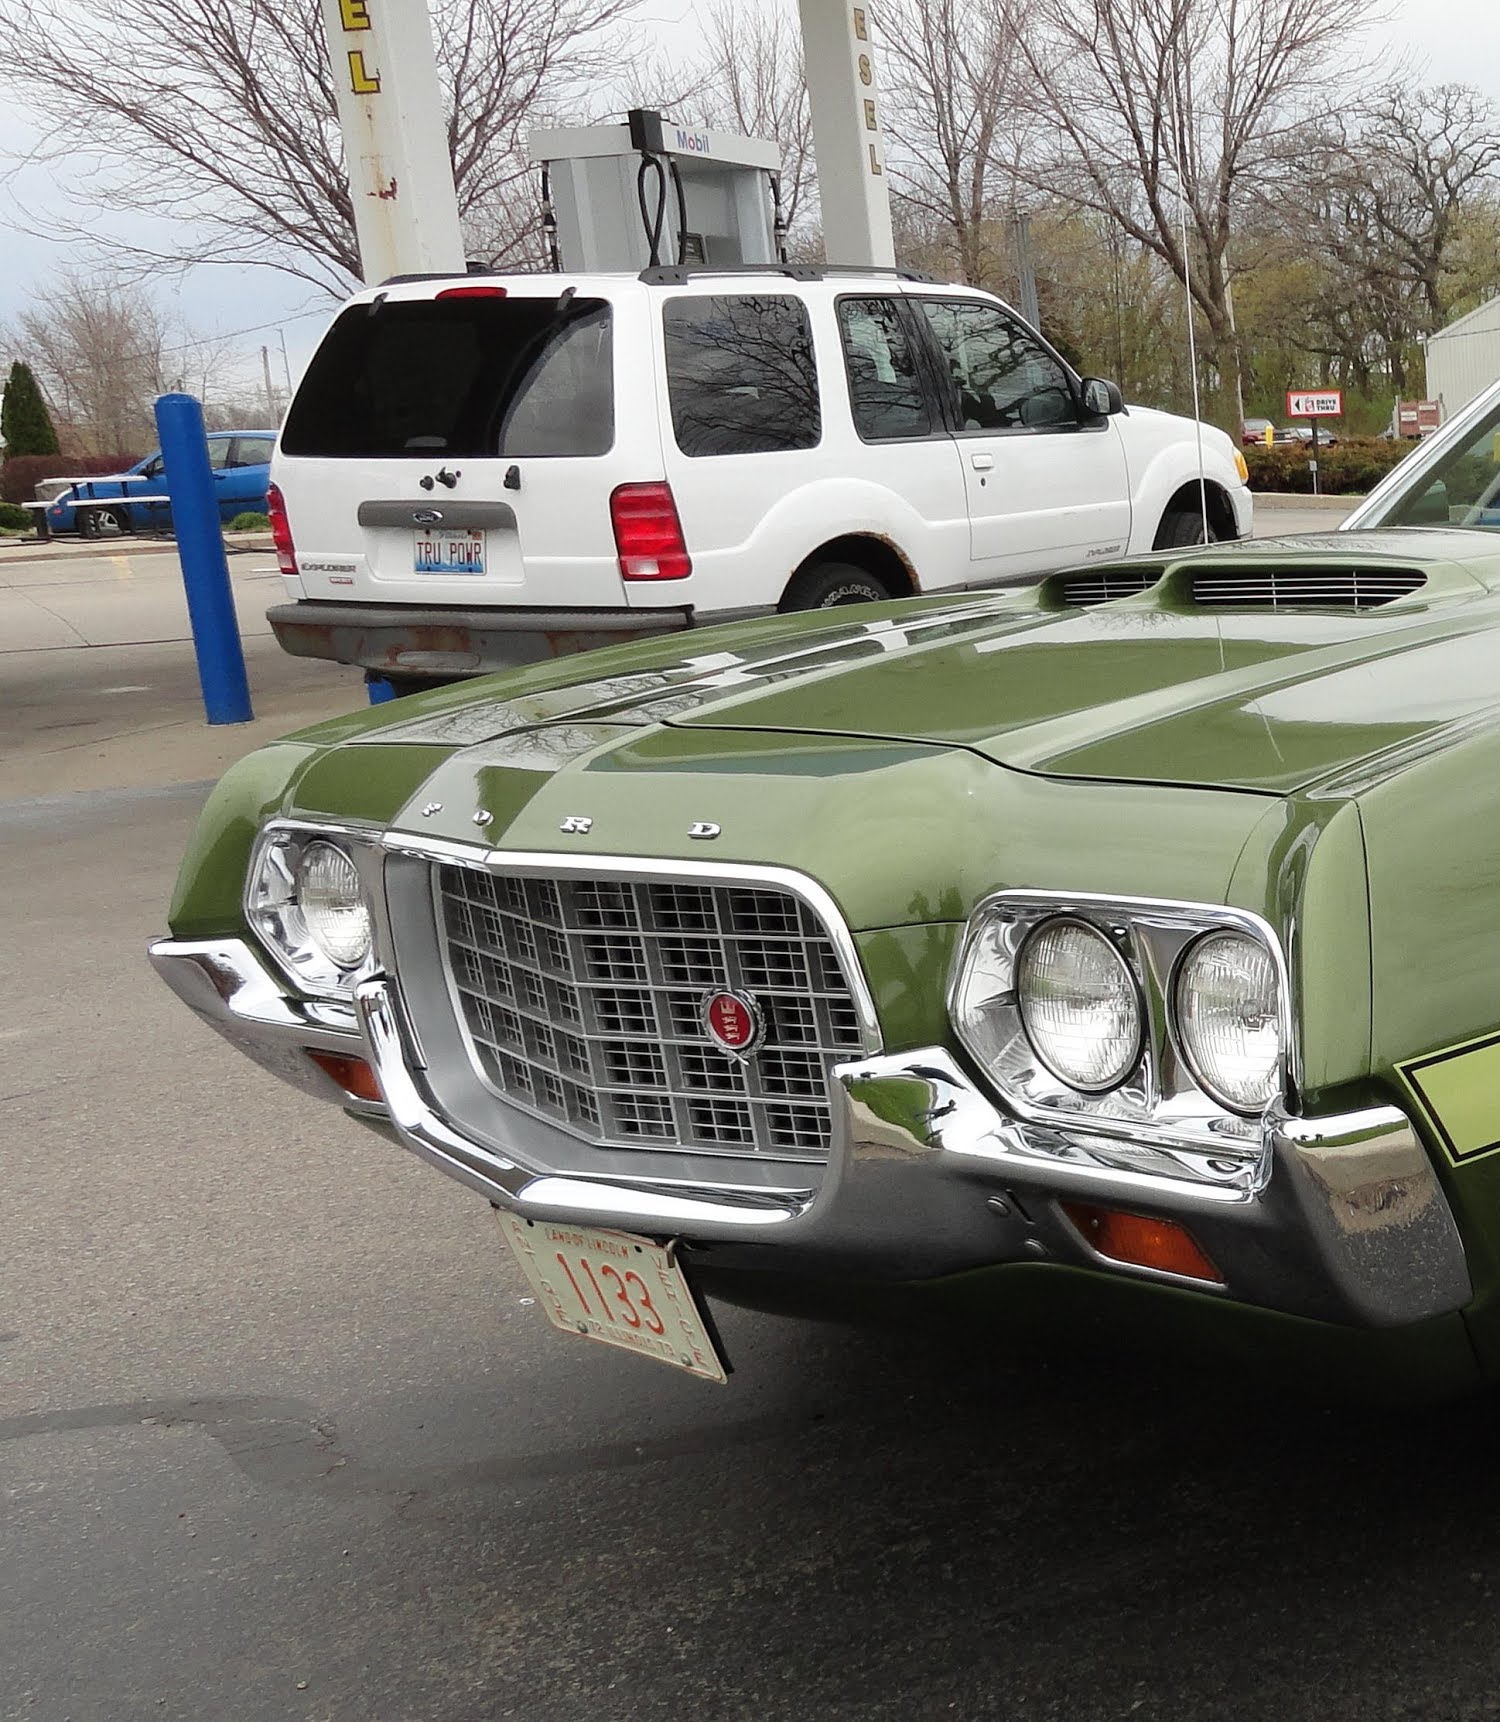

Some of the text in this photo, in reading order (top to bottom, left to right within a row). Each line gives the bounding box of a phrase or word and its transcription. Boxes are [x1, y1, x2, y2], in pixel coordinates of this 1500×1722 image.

[853, 7, 882, 176] ESEL
[676, 129, 710, 153] Mobil
[417, 542, 482, 565] TRU POWR
[586, 1239, 629, 1259] LINCOLN
[556, 1252, 665, 1336] 1133
[651, 1255, 708, 1368] VEHICLE
